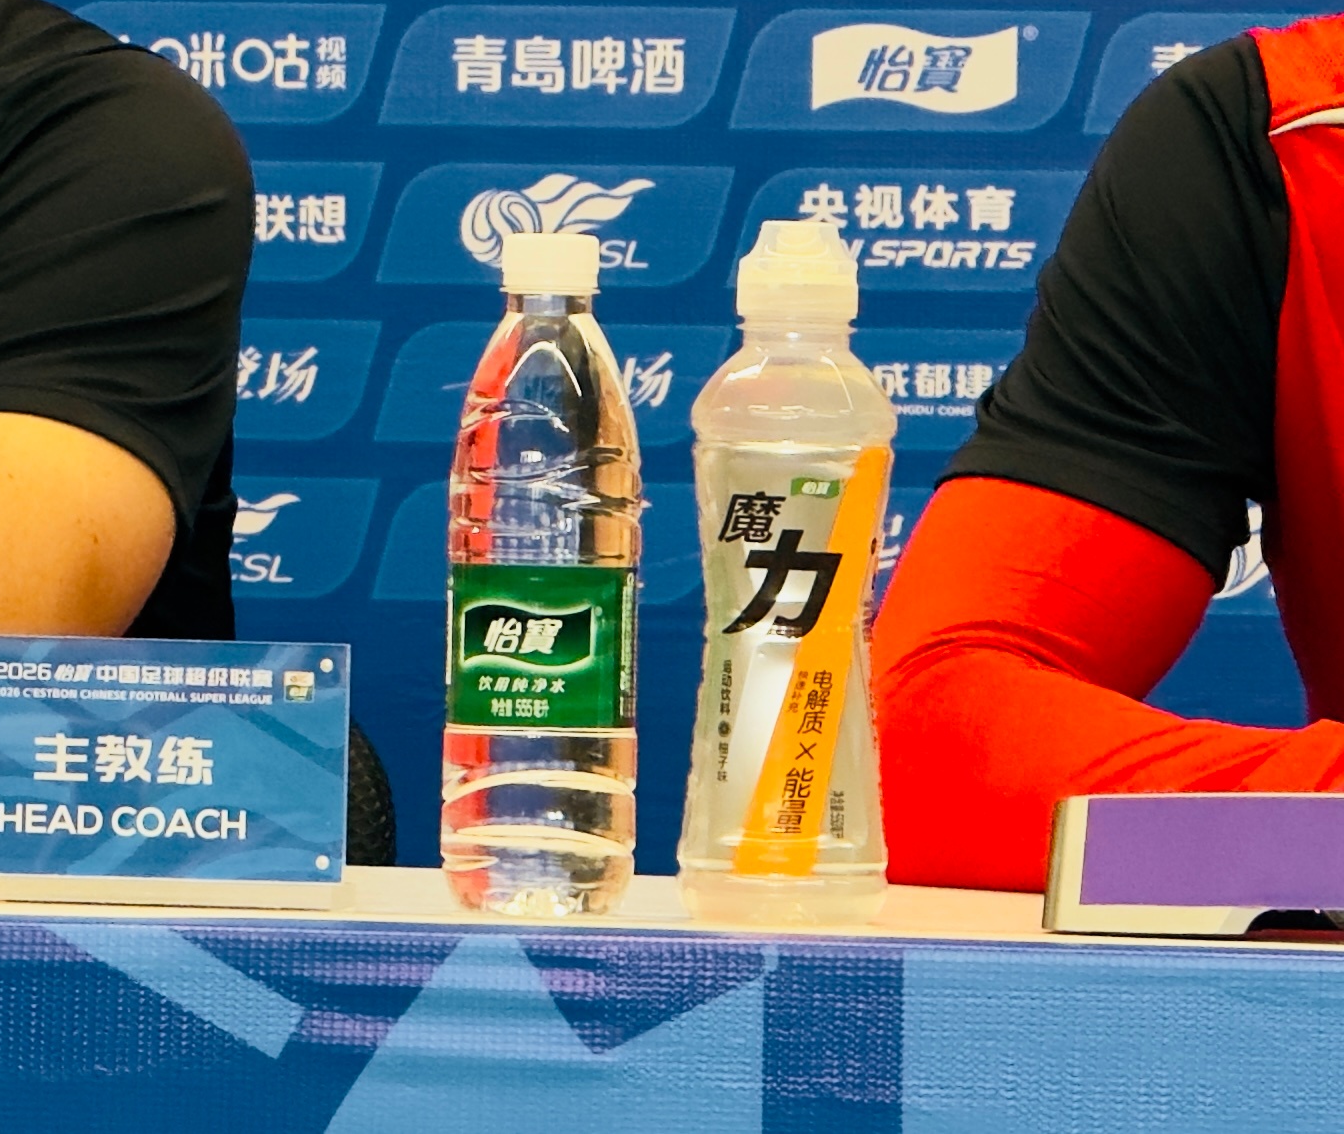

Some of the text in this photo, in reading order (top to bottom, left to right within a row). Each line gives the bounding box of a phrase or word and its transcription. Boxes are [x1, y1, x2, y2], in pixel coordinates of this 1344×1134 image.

[857, 44, 973, 94] 怡寶
[798, 182, 1016, 231] 央视体育
[599, 239, 649, 270] SL
[863, 239, 1037, 269] SPORTS
[872, 362, 1008, 400] 成都建
[228, 552, 294, 584] SL
[482, 617, 564, 656] 怡寶
[96, 664, 273, 688] 中国足球超级联赛
[129, 691, 187, 703] FOOTBALL
[190, 693, 227, 704] SUPER
[229, 694, 273, 705] LEAGUE
[32, 732, 215, 786] 主教练
[111, 806, 248, 841] COACH
